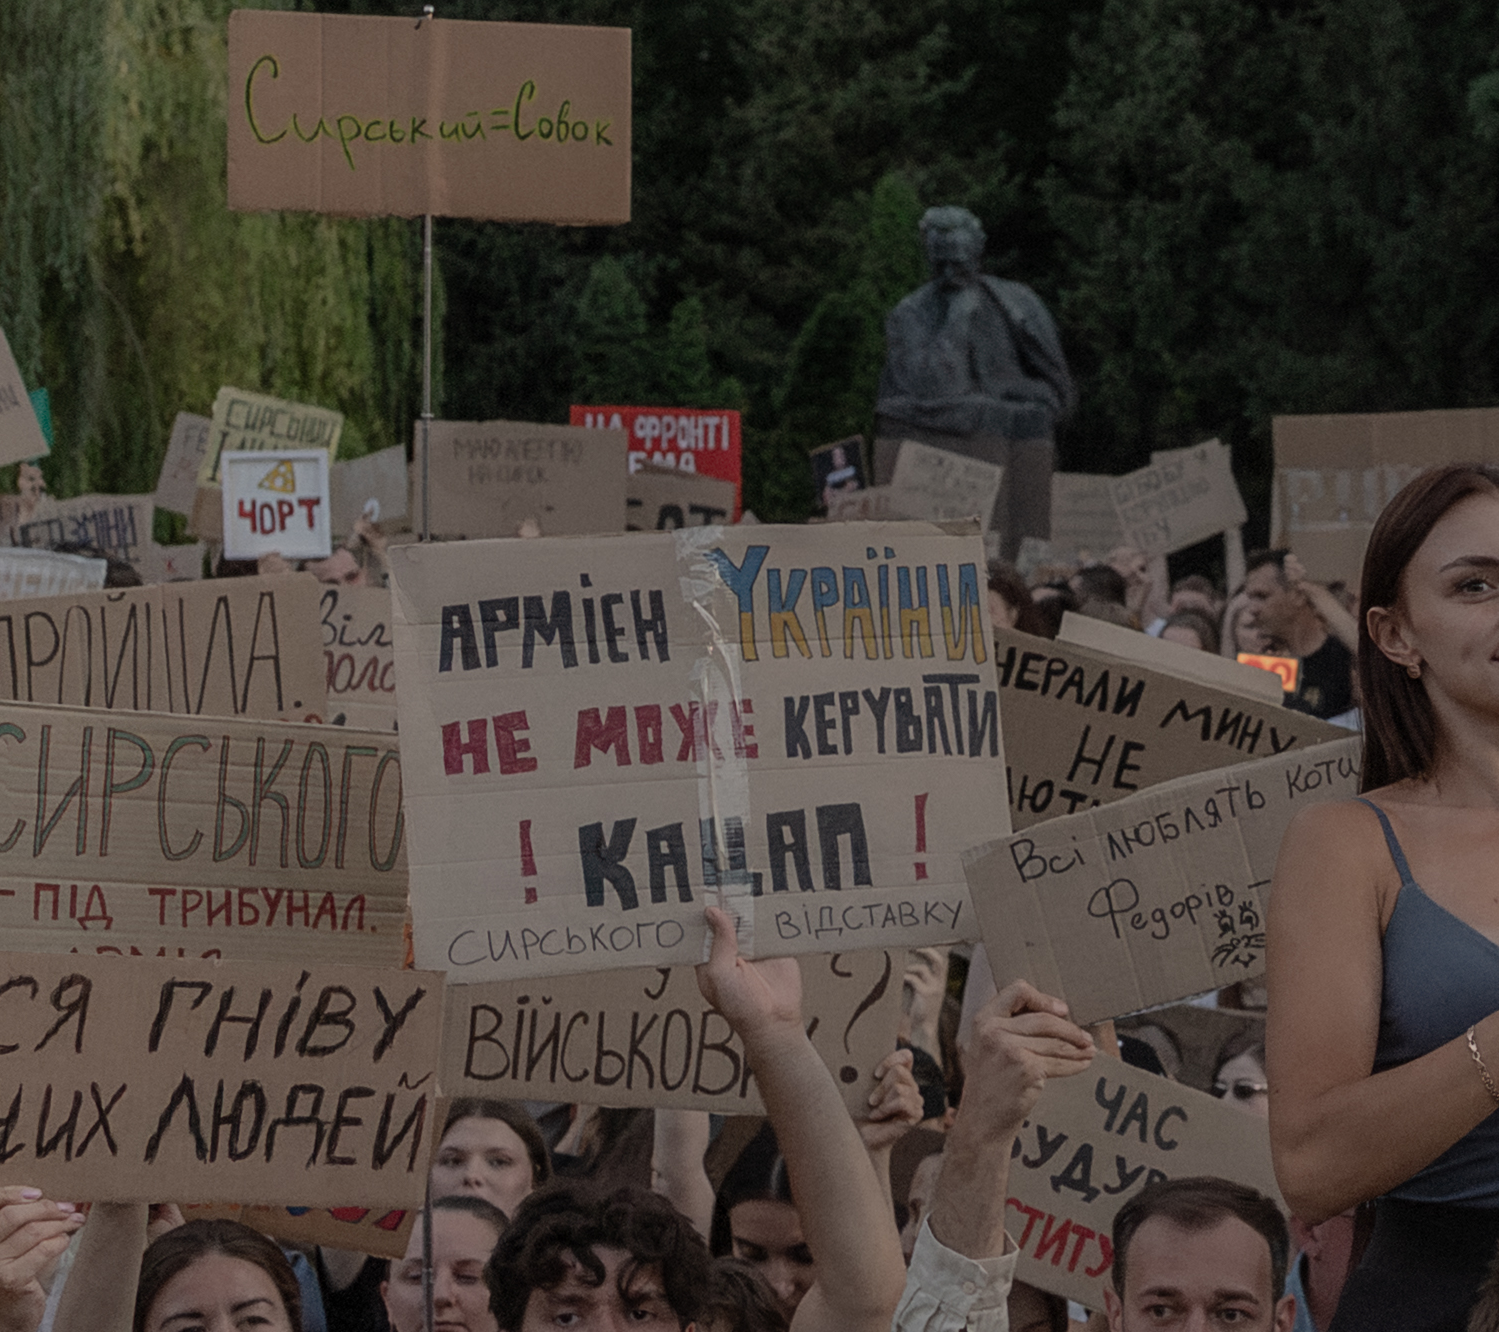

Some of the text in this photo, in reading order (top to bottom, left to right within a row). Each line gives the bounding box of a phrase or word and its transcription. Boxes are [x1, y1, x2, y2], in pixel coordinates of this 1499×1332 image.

[633, 414, 730, 451] ФРОНТІ
[237, 497, 321, 535] ЧОРТ
[711, 544, 989, 665] УКРАЇНИ
[442, 673, 1000, 777] НЕ МОЖЕ КЕРУВАТИ
[1066, 725, 1147, 792] НЕ
[578, 801, 874, 912] КАЦАП
[1009, 834, 1086, 885] Всі
[1107, 779, 1266, 860] ЛЮБЛЯТЬ
[32, 883, 379, 934] ПІД ТРИБУНАЛ.
[447, 899, 964, 967] СИРСЬКОГО ВІДСТАВКУ
[1087, 876, 1235, 941] Федорів
[149, 970, 427, 1063] ГНІВУ
[144, 1071, 434, 1175] ЛЮДЕЙ
[1094, 1076, 1189, 1152] ЧАС
